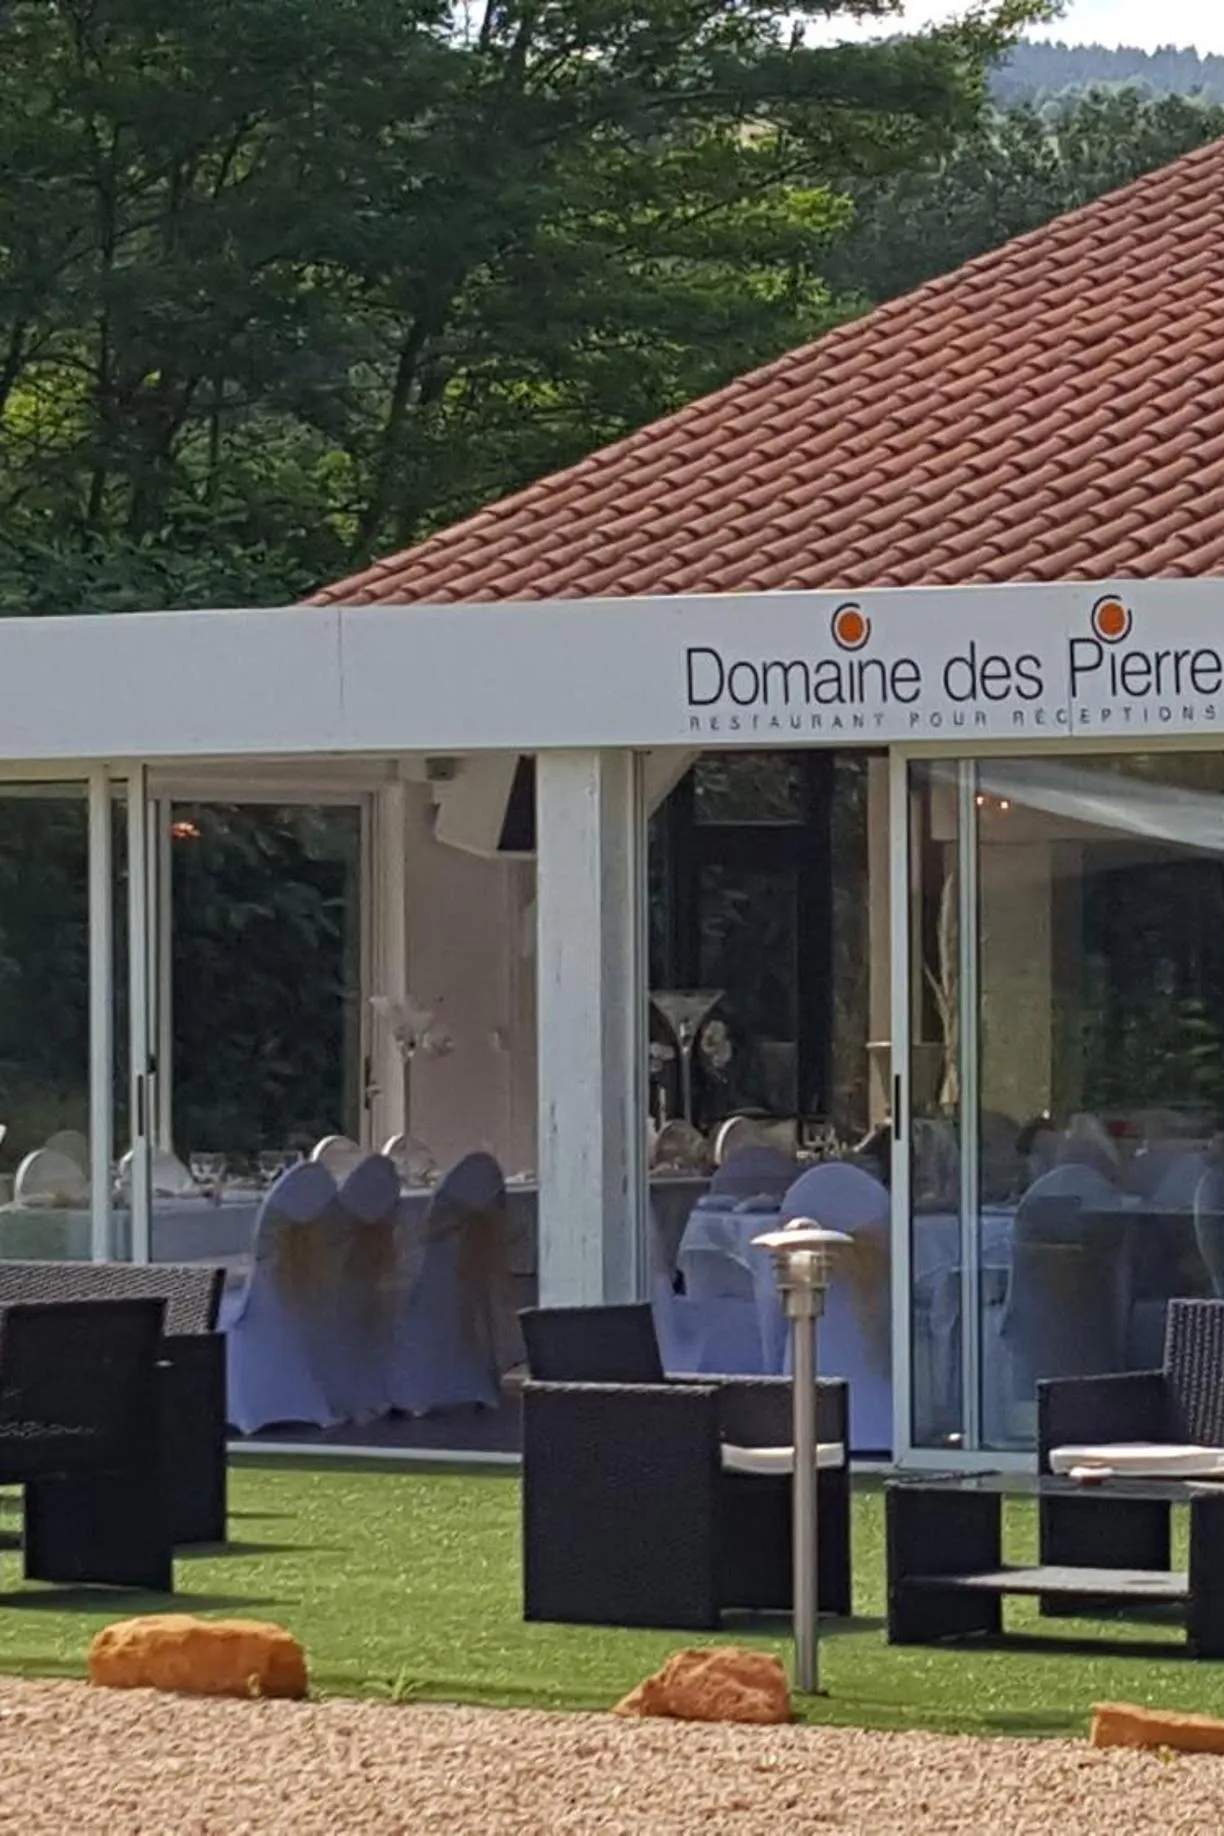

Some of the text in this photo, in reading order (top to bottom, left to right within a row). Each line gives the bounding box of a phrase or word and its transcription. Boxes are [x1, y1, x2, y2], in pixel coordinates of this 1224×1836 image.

[686, 602, 922, 706] Domaine
[943, 640, 1044, 702] des
[689, 713, 884, 731] RESTAURANT
[909, 711, 987, 728] POUR
